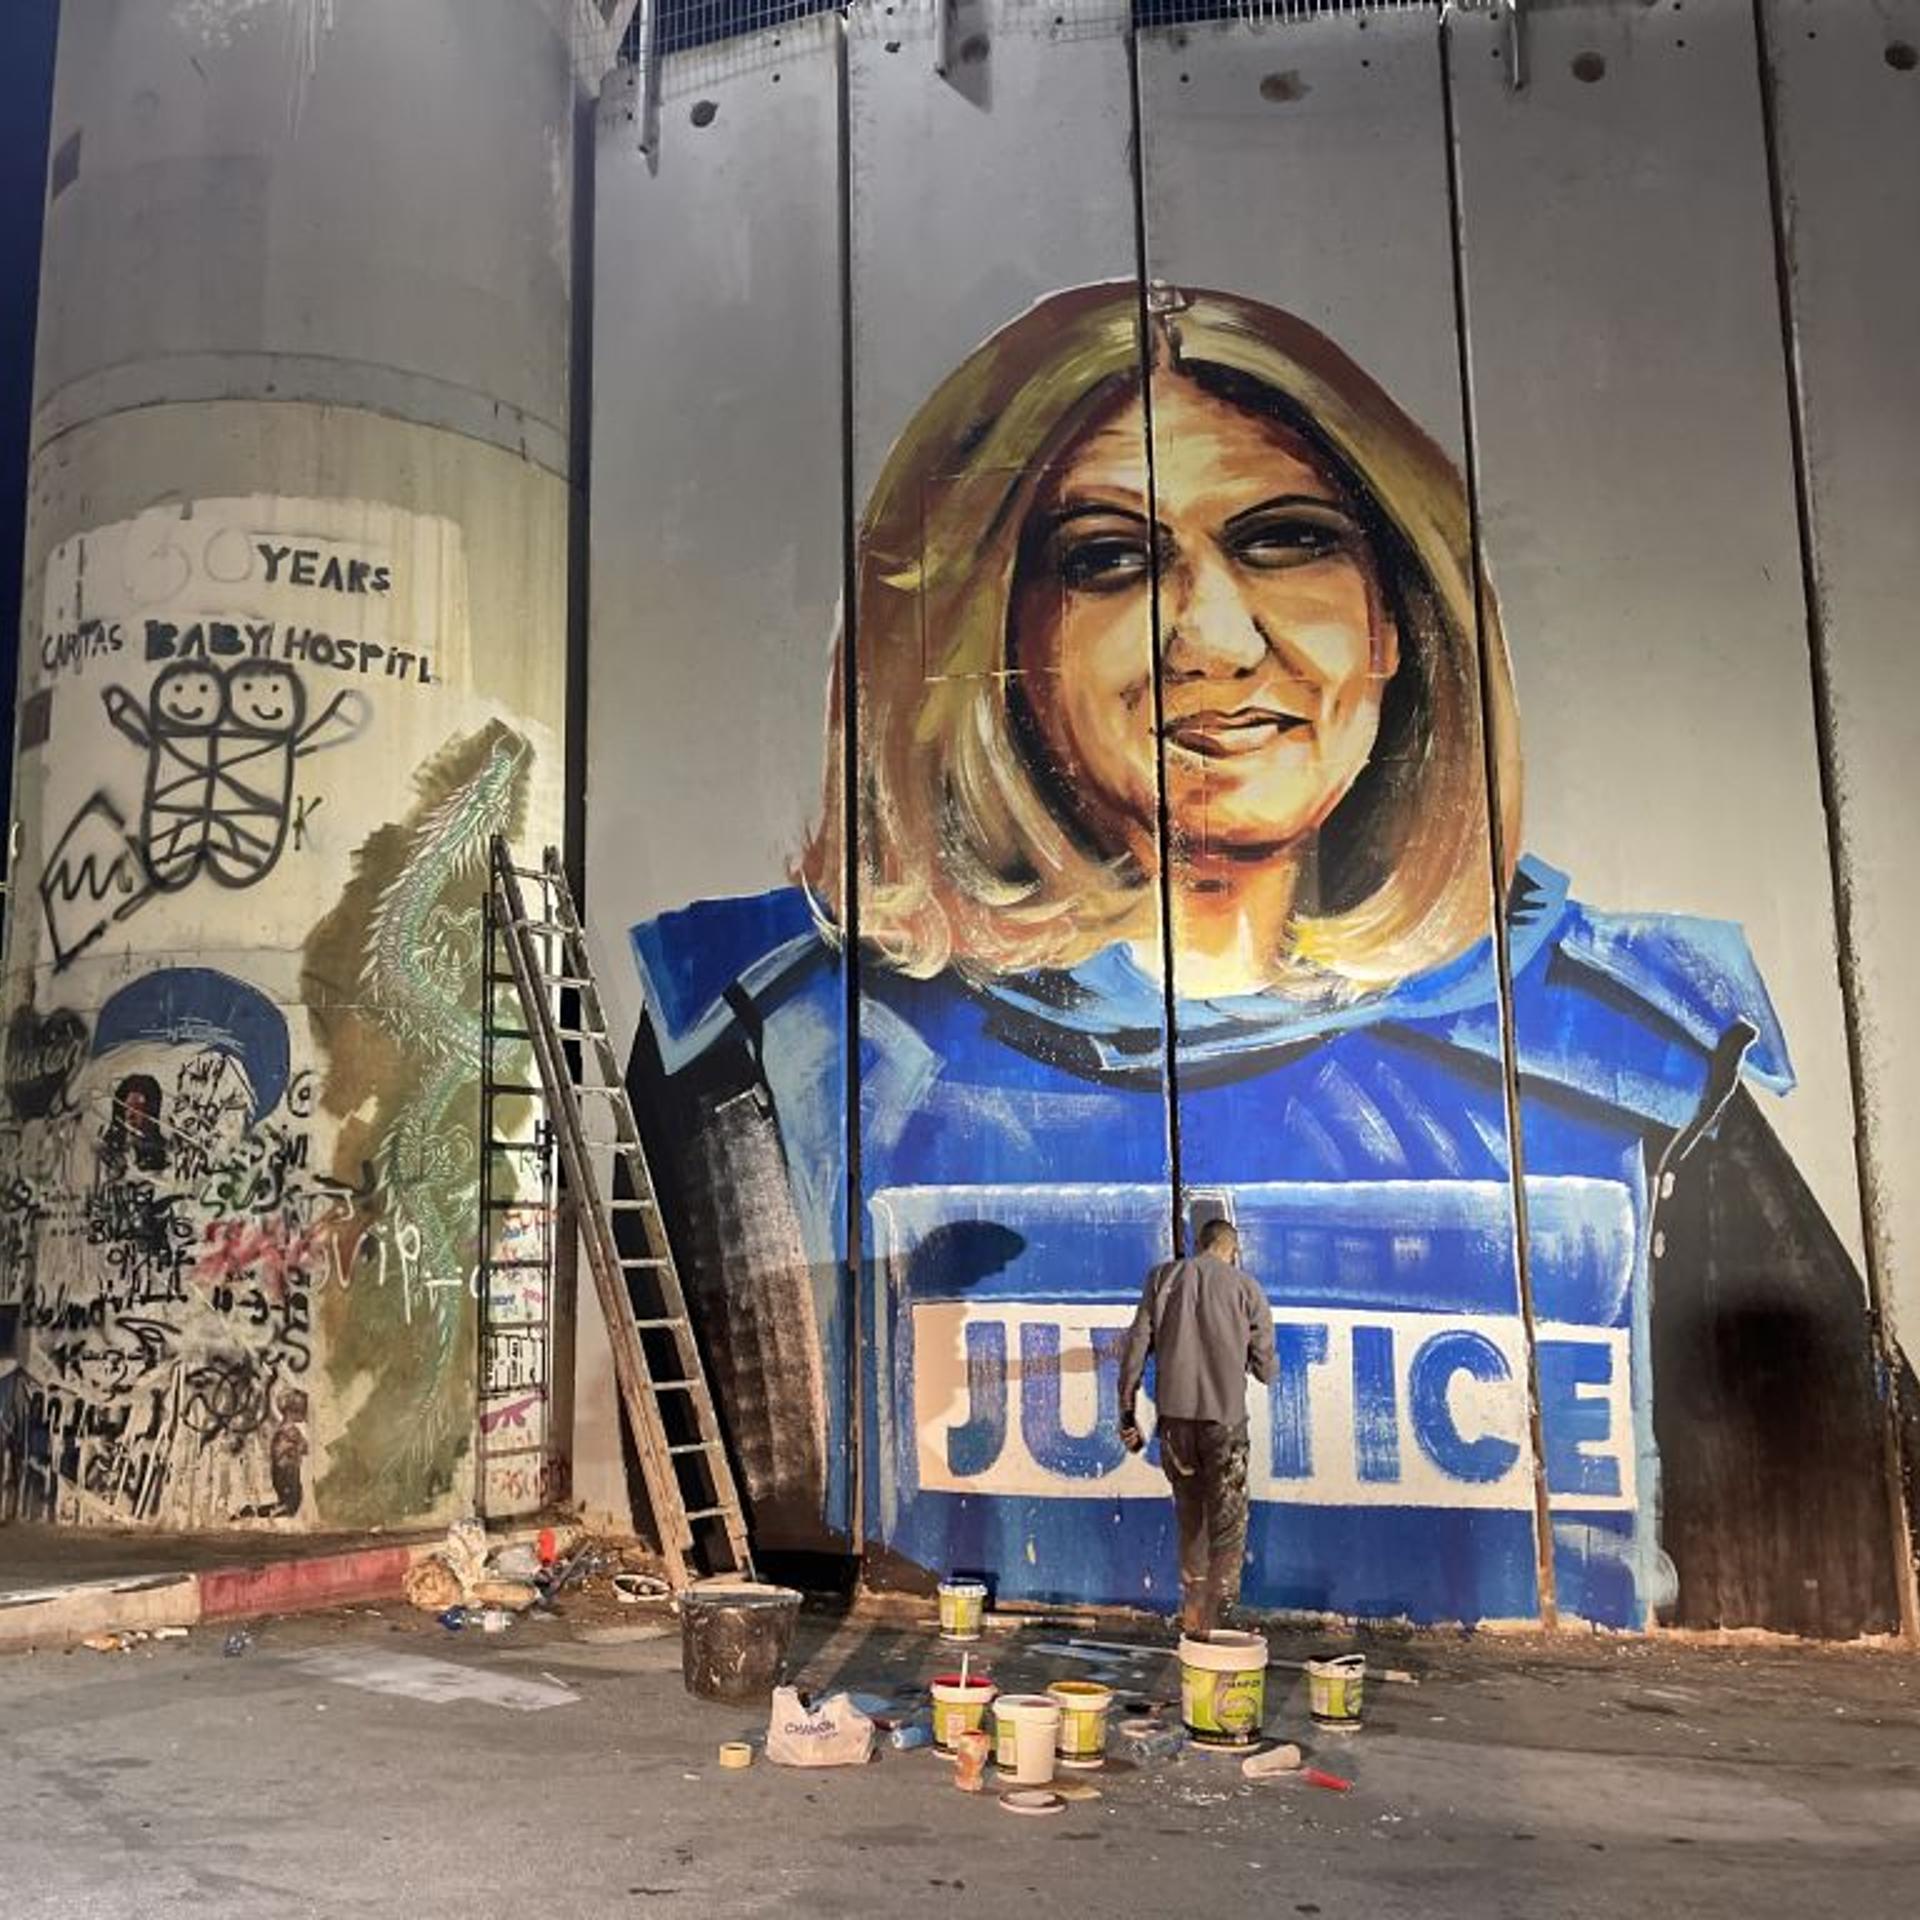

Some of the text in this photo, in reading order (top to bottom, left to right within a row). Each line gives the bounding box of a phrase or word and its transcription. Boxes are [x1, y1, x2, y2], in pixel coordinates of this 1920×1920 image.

[258, 543, 391, 594] YEARS
[144, 618, 270, 662] BABY
[947, 1322, 1621, 1497] JUTICE
